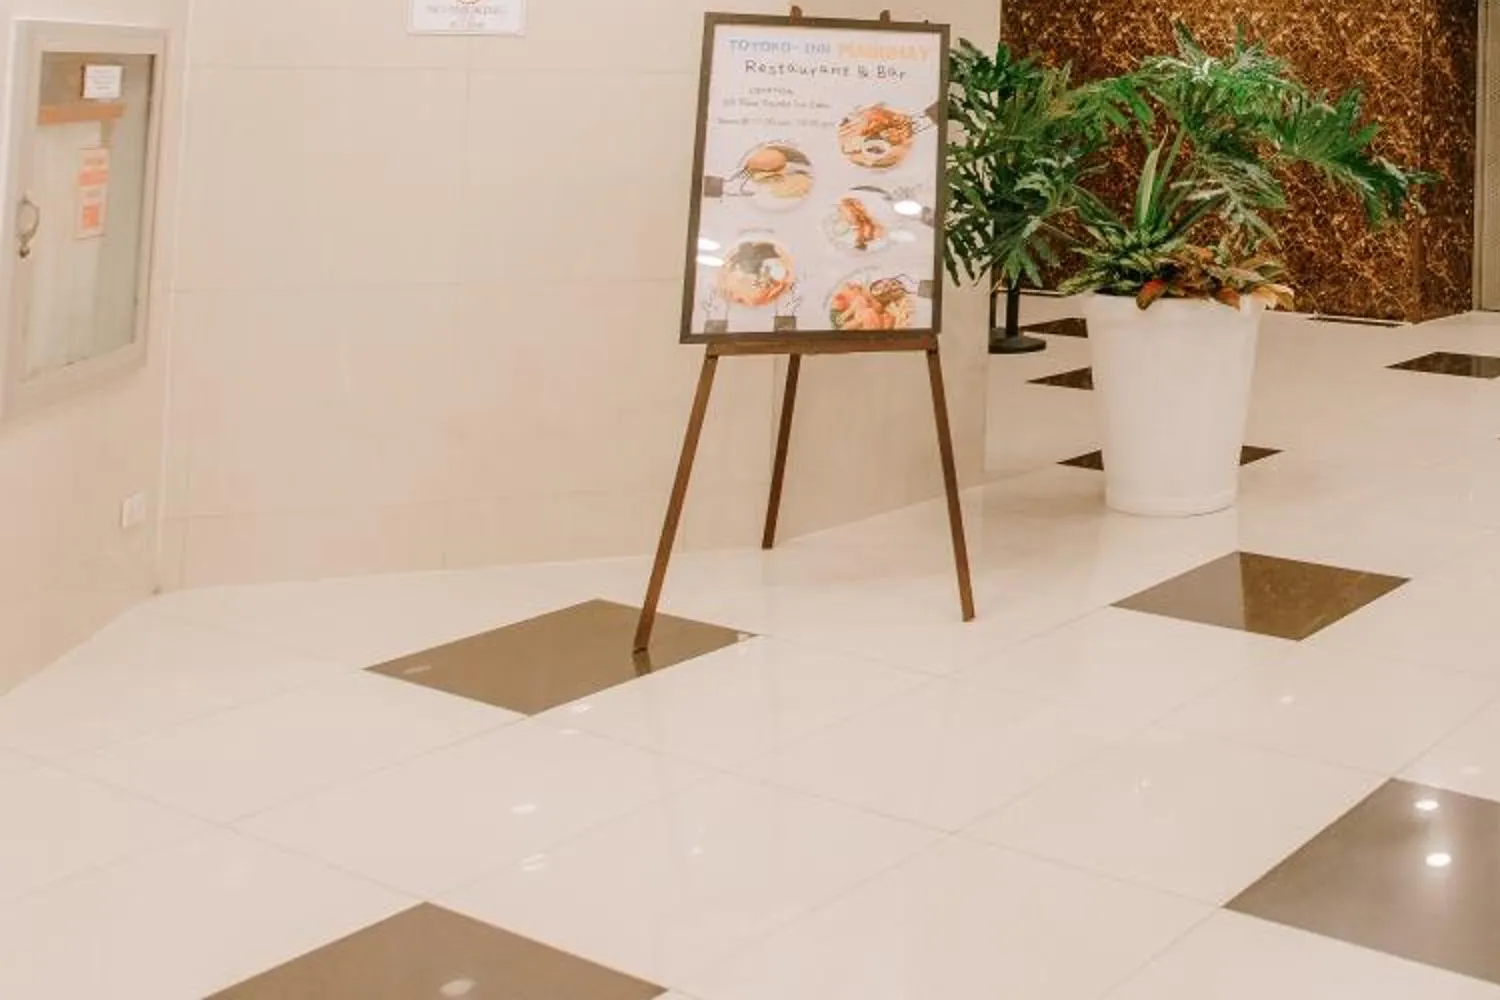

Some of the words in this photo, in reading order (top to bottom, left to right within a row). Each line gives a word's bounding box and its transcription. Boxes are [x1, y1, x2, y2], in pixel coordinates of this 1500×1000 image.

[745, 59, 849, 78] Restaurant
[857, 64, 869, 78] &
[876, 64, 907, 81] Bar
